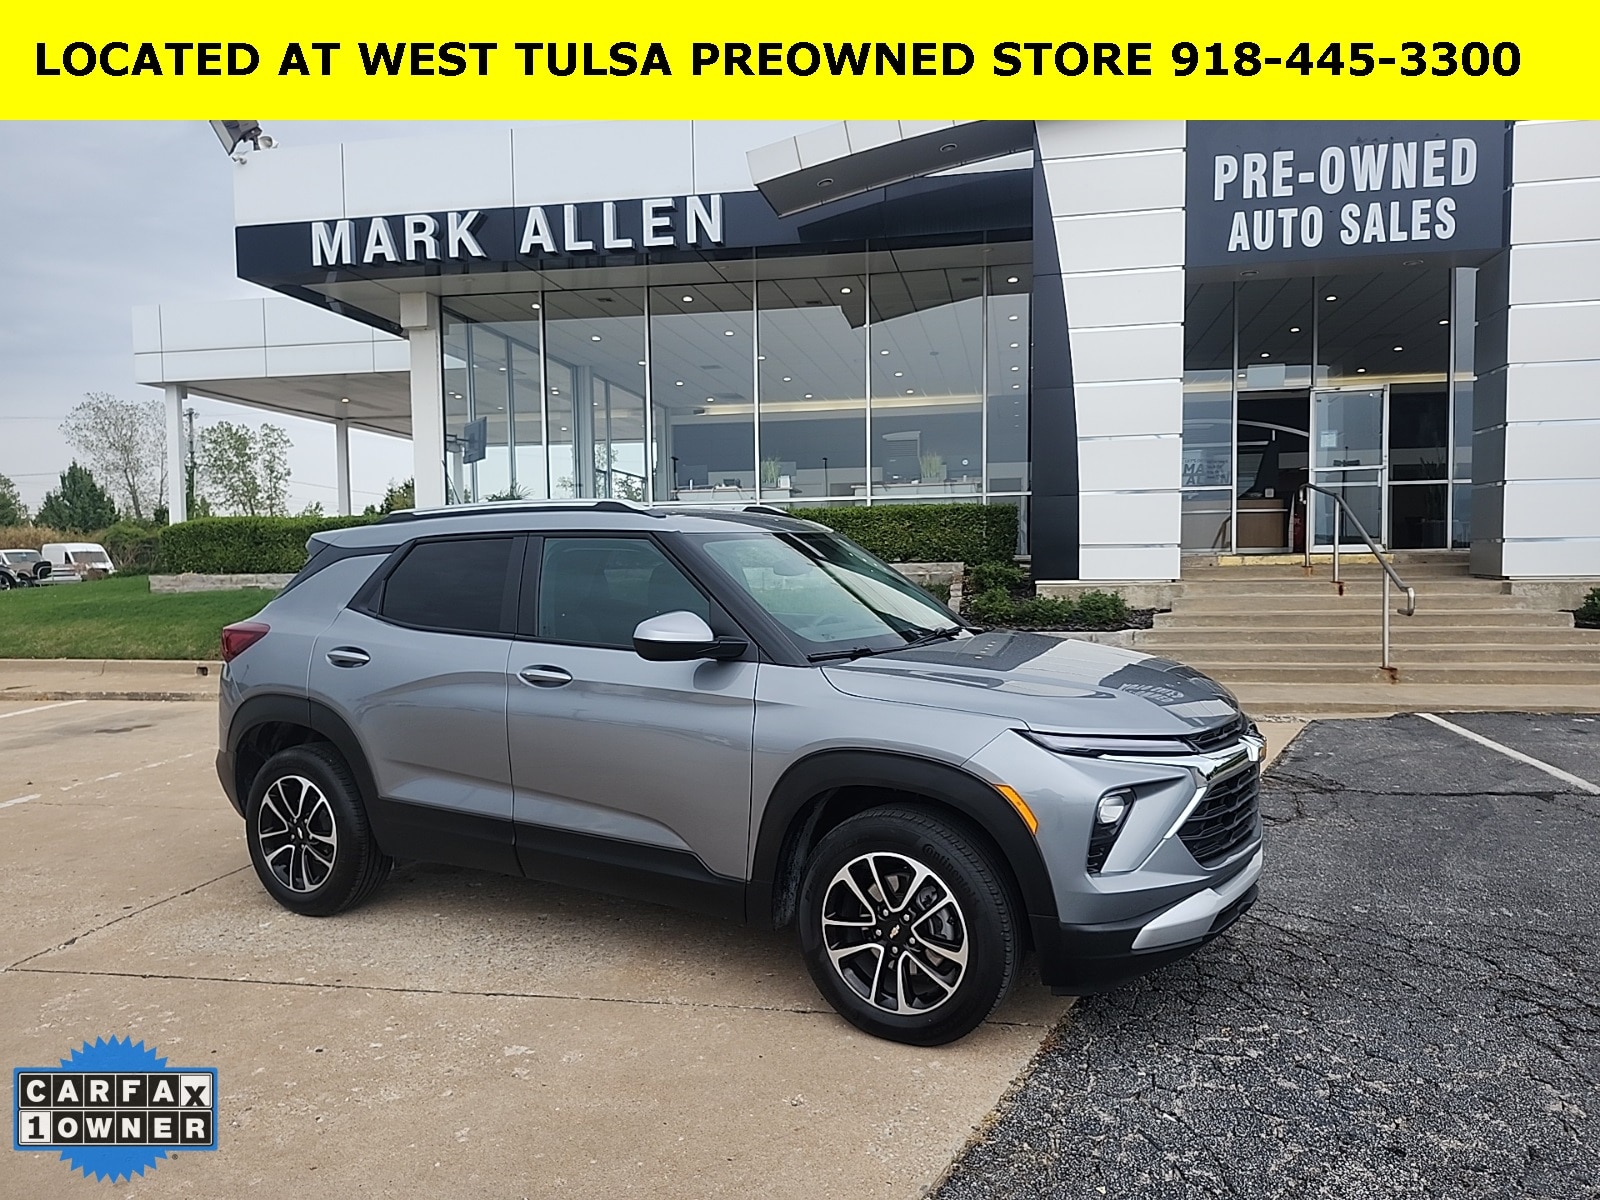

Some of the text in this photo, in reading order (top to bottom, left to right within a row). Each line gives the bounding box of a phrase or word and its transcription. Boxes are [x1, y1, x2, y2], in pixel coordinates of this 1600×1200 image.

[1213, 138, 1478, 201] PRE-OWNED
[311, 194, 723, 266] MARK ALLEN
[1227, 197, 1457, 251] AUTO SALES
